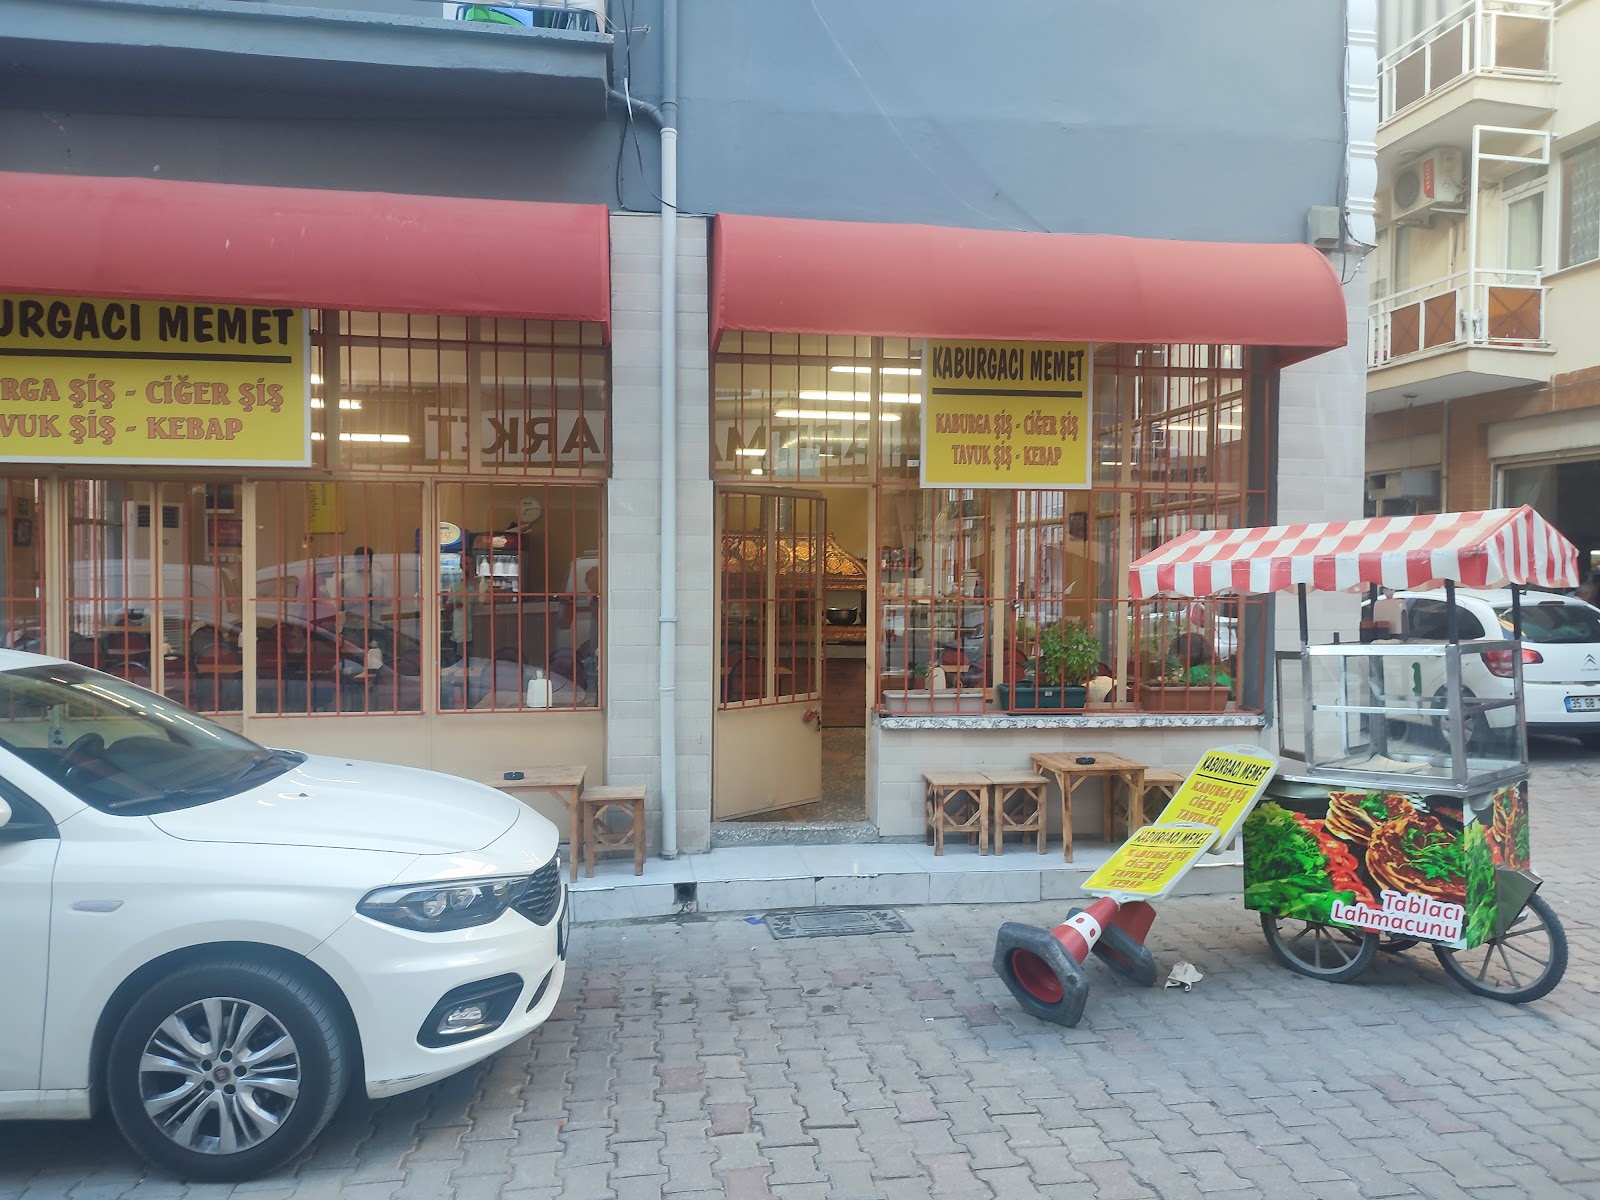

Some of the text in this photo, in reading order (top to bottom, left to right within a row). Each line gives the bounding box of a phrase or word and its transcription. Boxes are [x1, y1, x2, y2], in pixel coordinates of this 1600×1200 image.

[158, 306, 294, 345] MEMET
[932, 346, 1084, 382] KABURGACI MEMET
[68, 374, 116, 409] ŞİŞ
[146, 375, 231, 405] CİĞER
[238, 378, 284, 412] ŞİŞ
[69, 409, 116, 445] ŞİŞ
[146, 416, 243, 440] KEBAP
[935, 413, 991, 435] KABURGA
[994, 409, 1012, 440] ŞİŞ
[1023, 409, 1057, 436] CİĞER
[1060, 411, 1078, 441] ŞİŞ
[952, 445, 991, 465] TAVUK
[994, 440, 1012, 471] ŞİŞ
[1023, 446, 1062, 466] KEBAP
[1200, 755, 1270, 781] KABURGACI MEMET
[1191, 780, 1233, 798] KABURGA
[1176, 808, 1208, 823] TAVUK
[1134, 830, 1213, 845] KABURGACI MEMET
[1125, 849, 1173, 859] KABURGA
[1107, 879, 1144, 888] KEBAP
[1111, 869, 1147, 878] TAVUK
[1334, 903, 1457, 939] Lahmacunu
[1384, 893, 1460, 921] Tablacı
